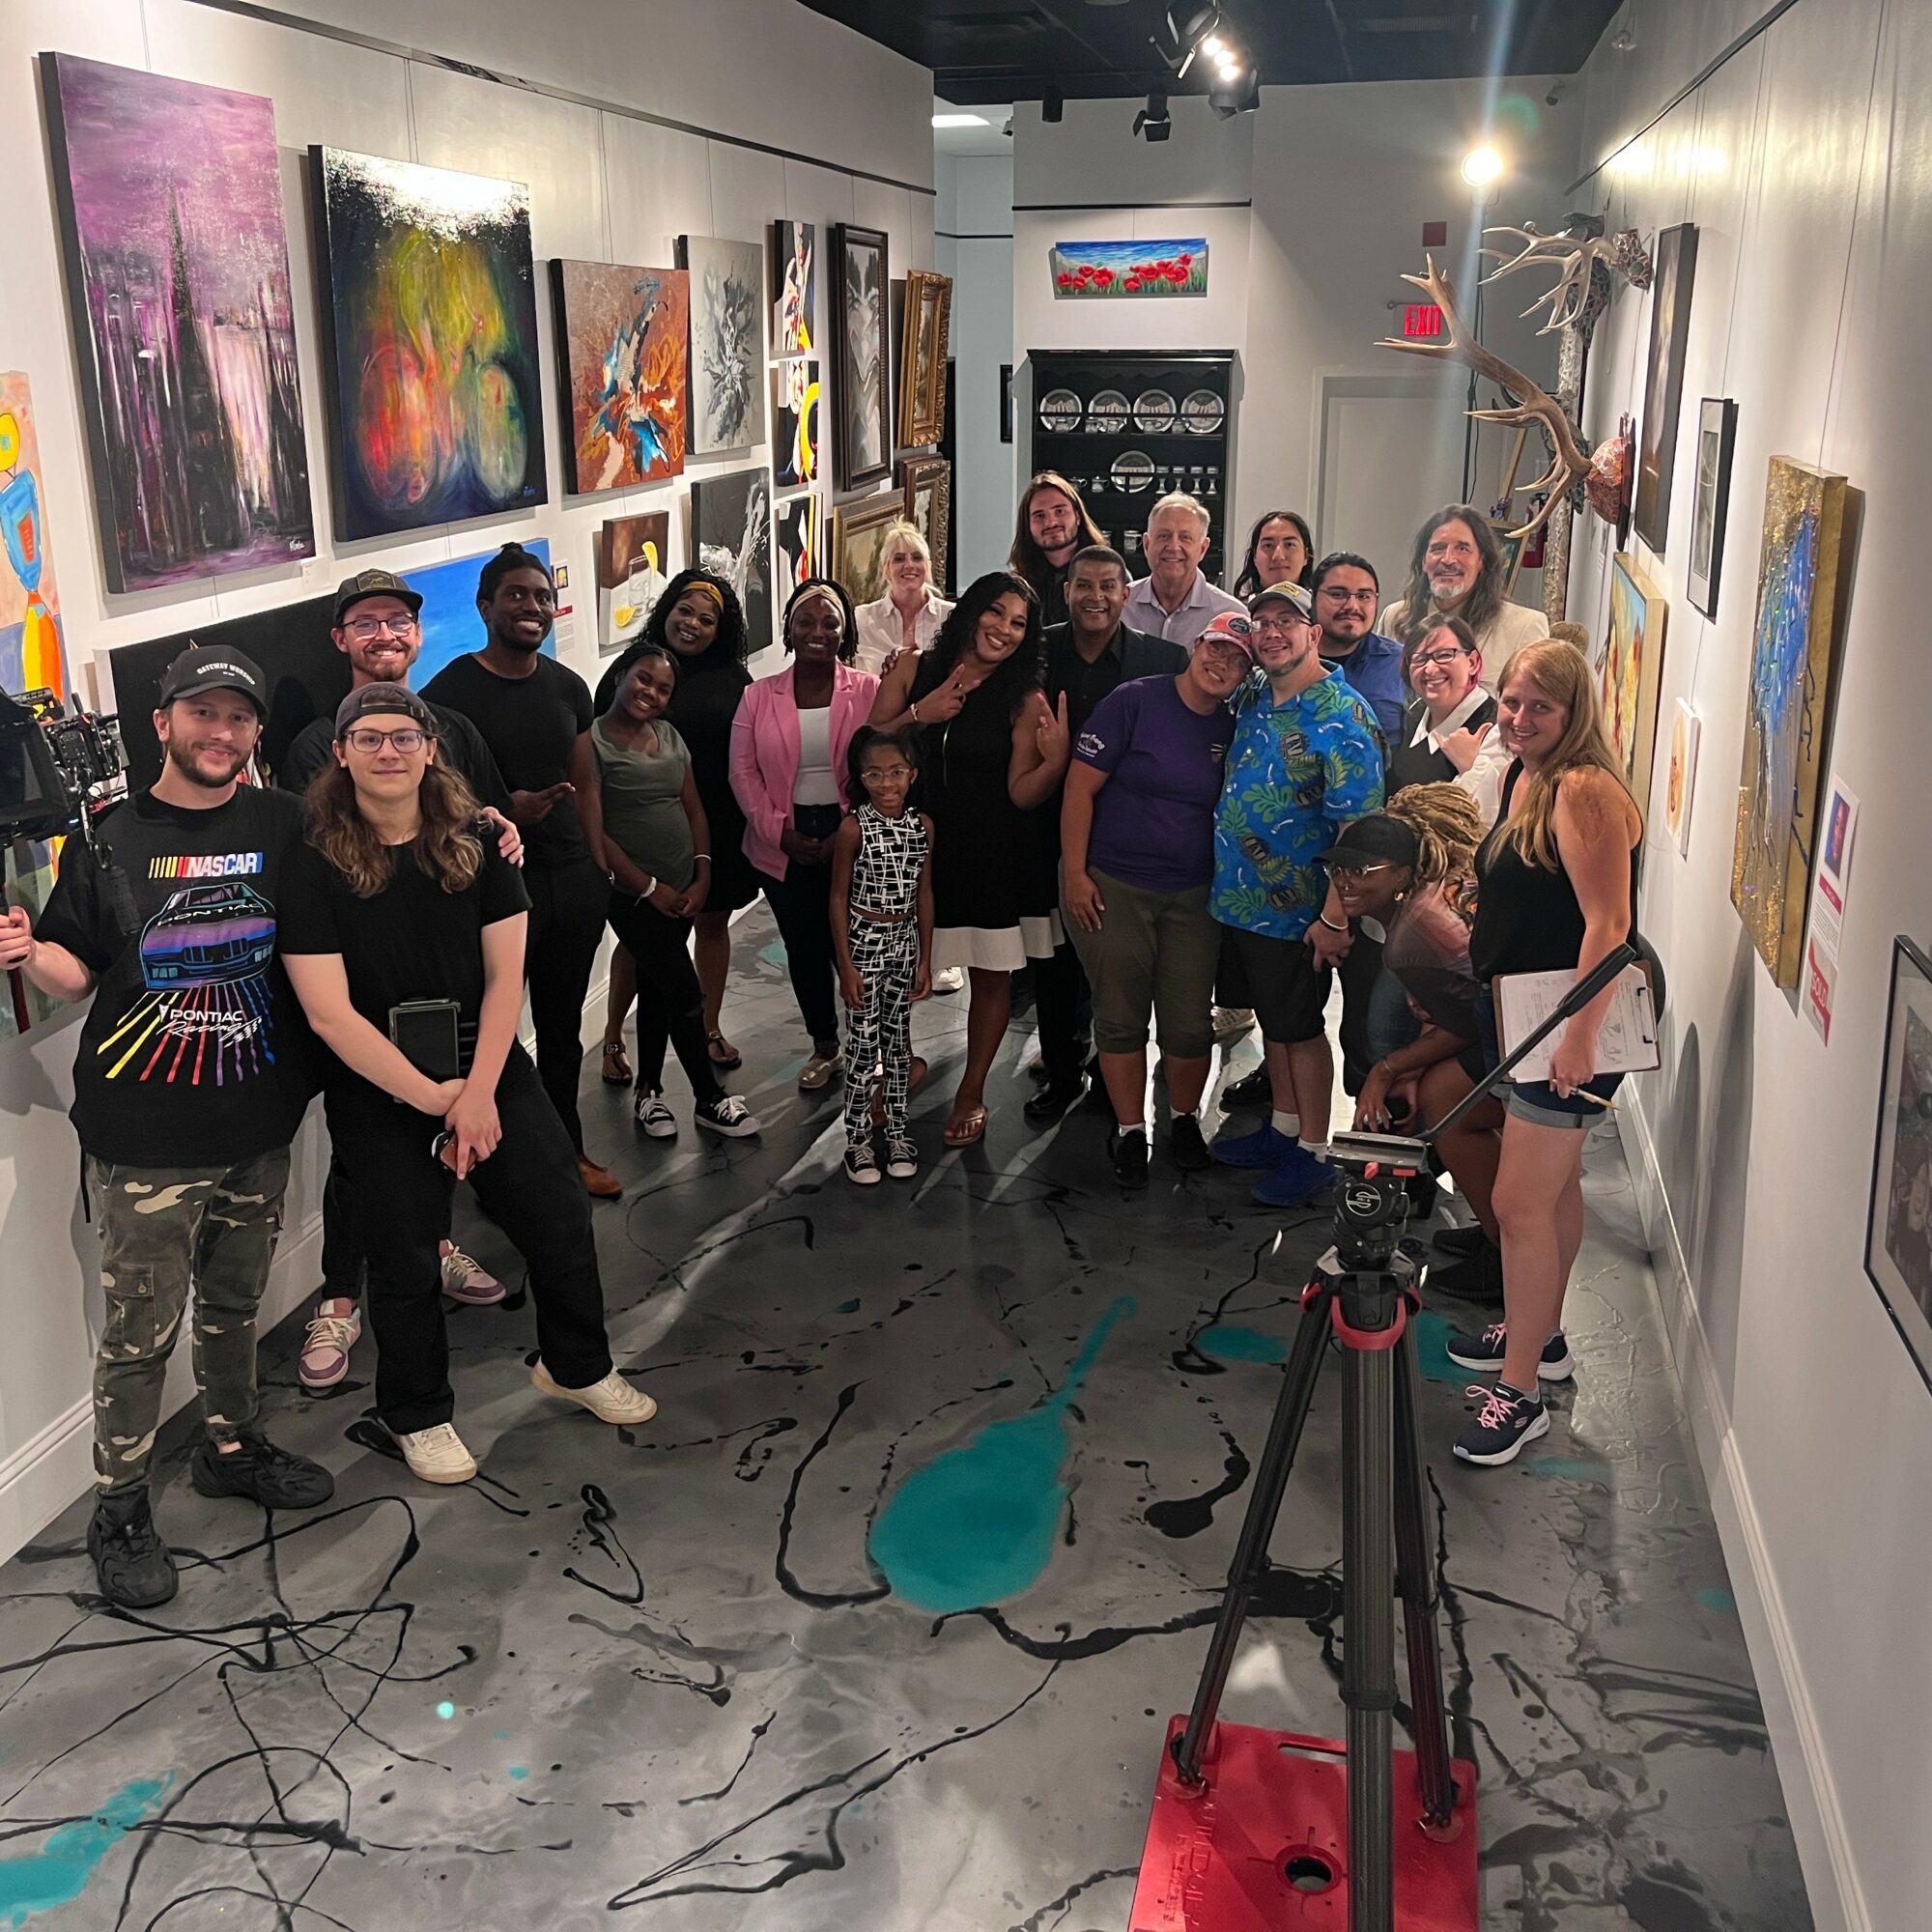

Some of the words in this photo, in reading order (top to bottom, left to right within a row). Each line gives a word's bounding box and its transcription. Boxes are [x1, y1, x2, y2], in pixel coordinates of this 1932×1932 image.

[1404, 305, 1441, 335] EXIT
[196, 663, 229, 674] GATEWAY
[185, 852, 258, 878] NASCAR
[157, 903, 262, 926] PONTIAC
[1811, 971, 1829, 1009] SOLD
[169, 1009, 243, 1023] PONTIAC
[156, 1017, 261, 1042] Racing
